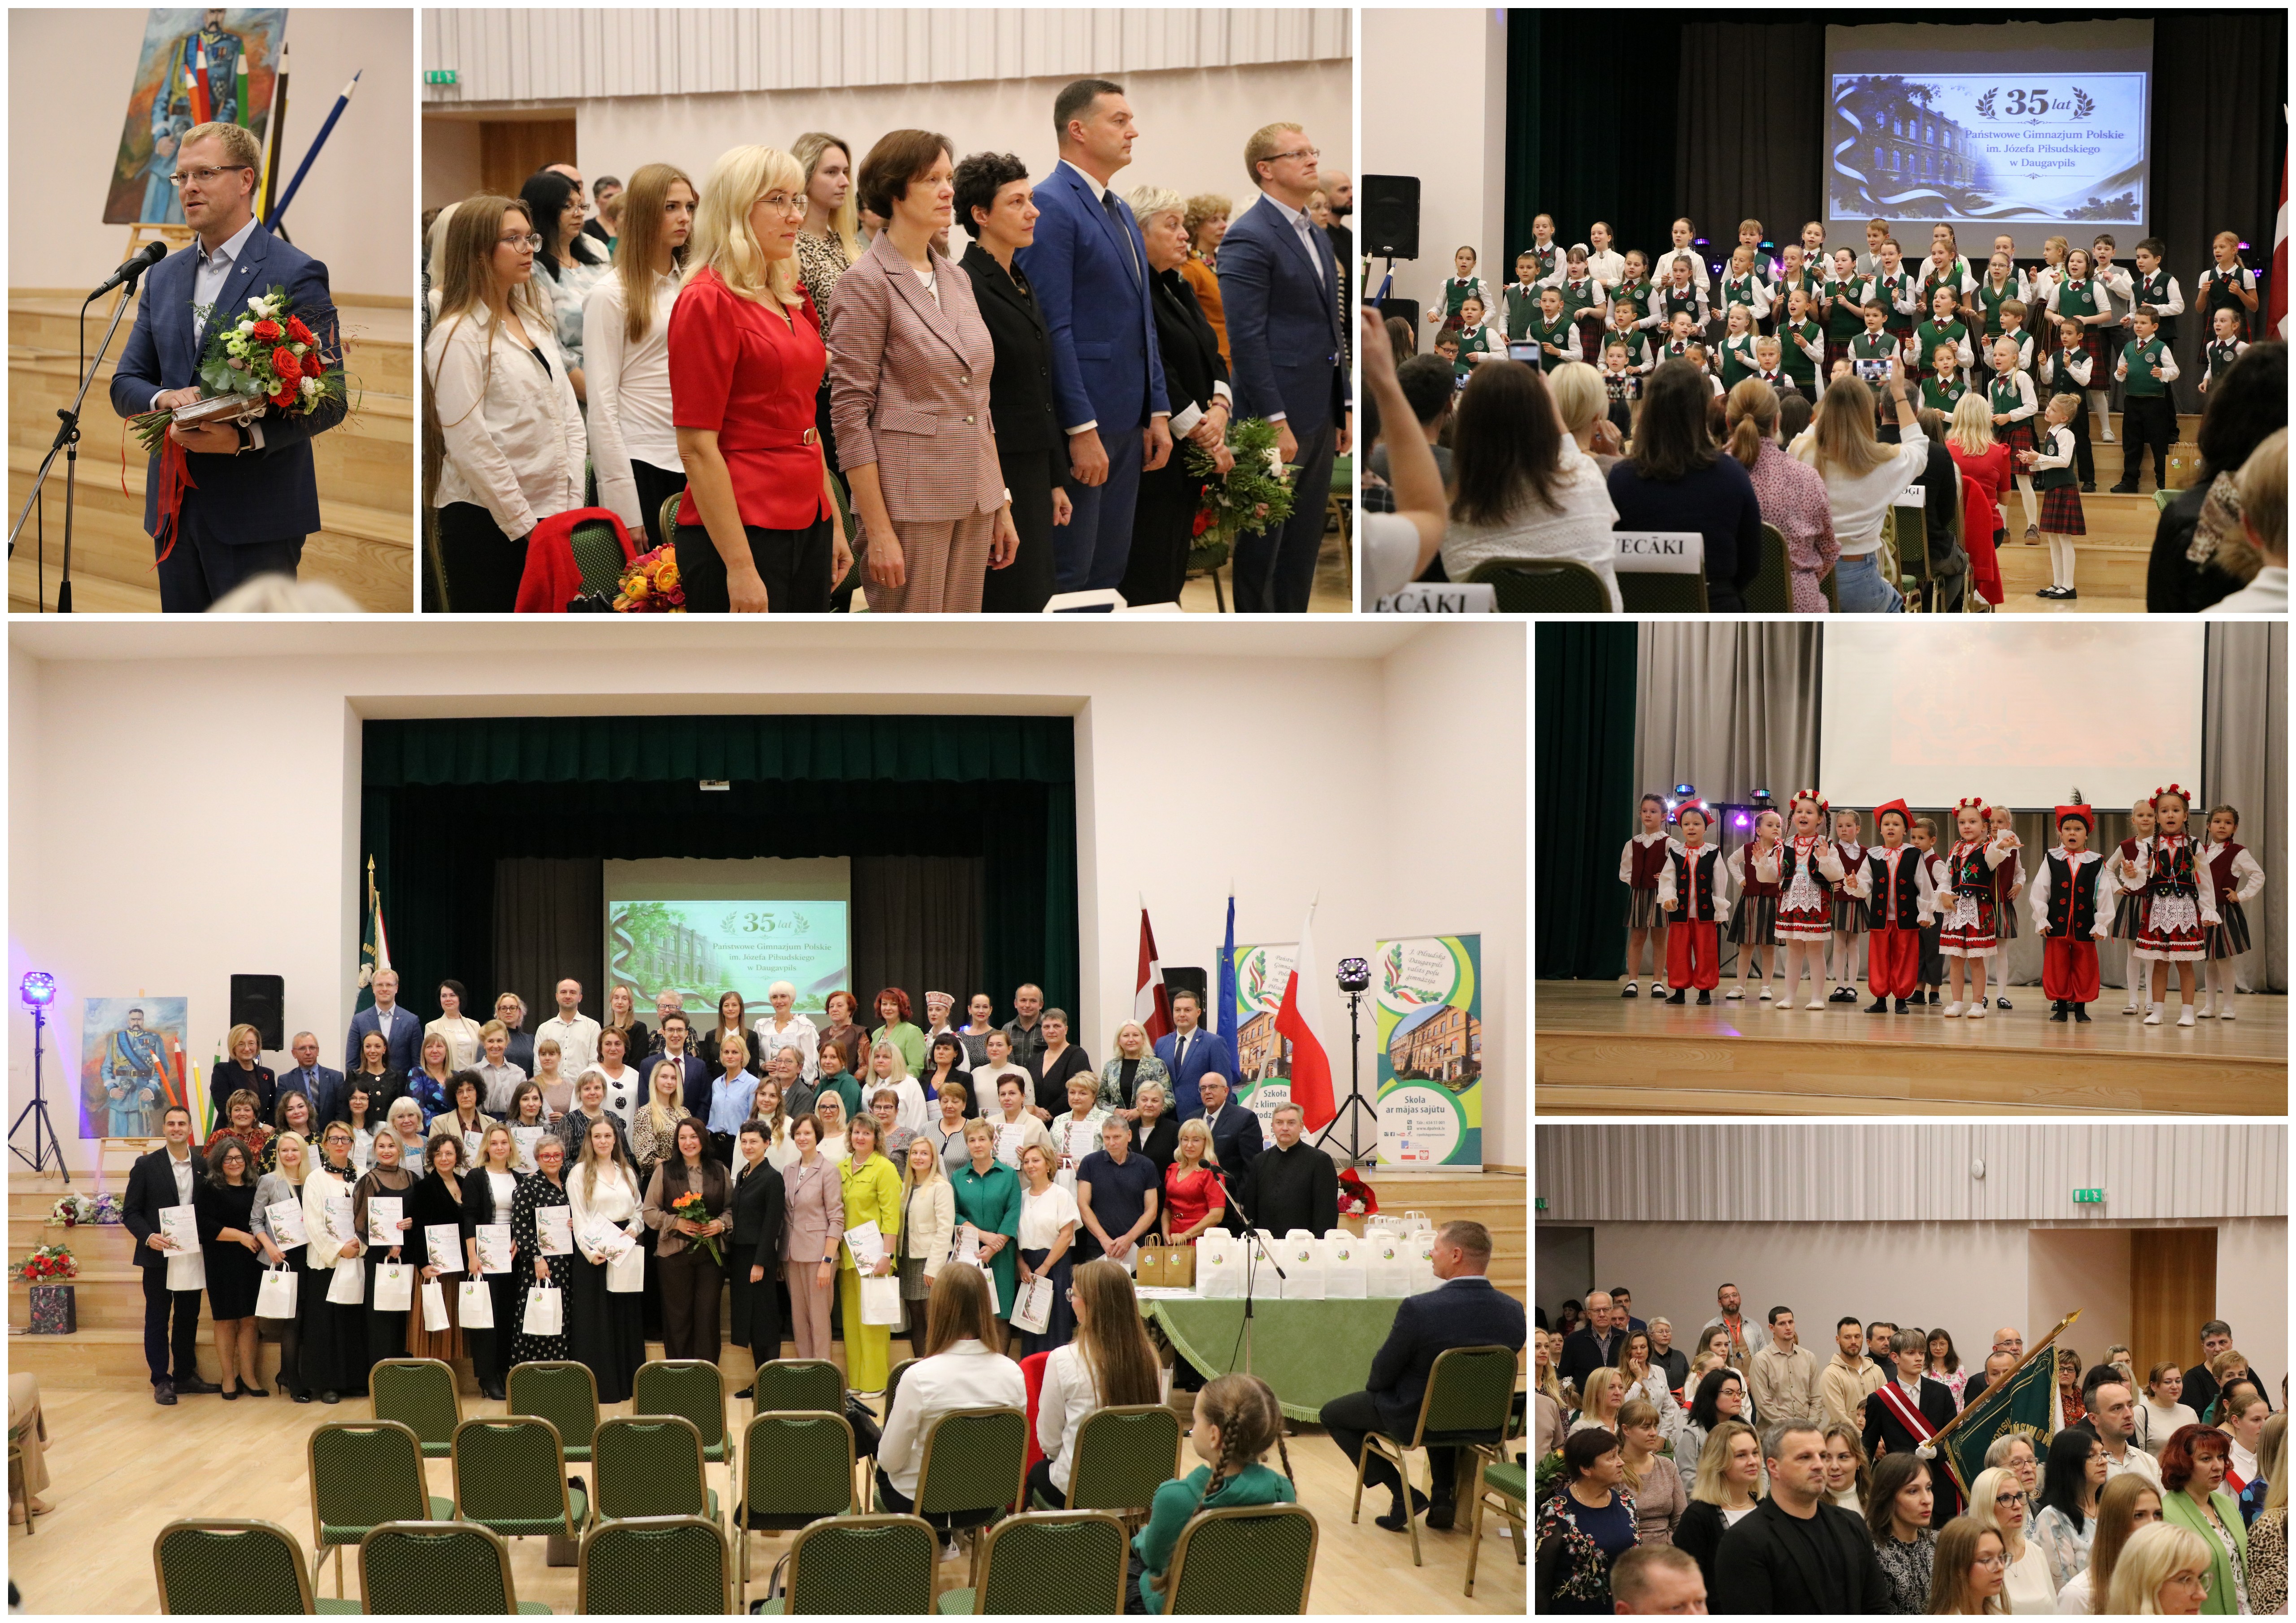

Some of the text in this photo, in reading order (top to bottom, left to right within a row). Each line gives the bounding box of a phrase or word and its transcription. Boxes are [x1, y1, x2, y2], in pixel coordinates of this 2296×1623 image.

[2005, 89, 2072, 115] 35 lat
[1965, 130, 2124, 140] Państwowe Gimnazjum Polskie
[1986, 144, 2100, 155] im. Józefa Piłsudskiego
[2021, 159, 2075, 169] Daugavpils
[1374, 589, 1465, 613] ECĀKI
[743, 912, 792, 932] 35 lat
[756, 964, 796, 972] Daugavpils
[1409, 957, 1443, 968] Daugavpils
[1396, 1106, 1418, 1115] mājas
[1420, 1106, 1444, 1115] sajūtu
